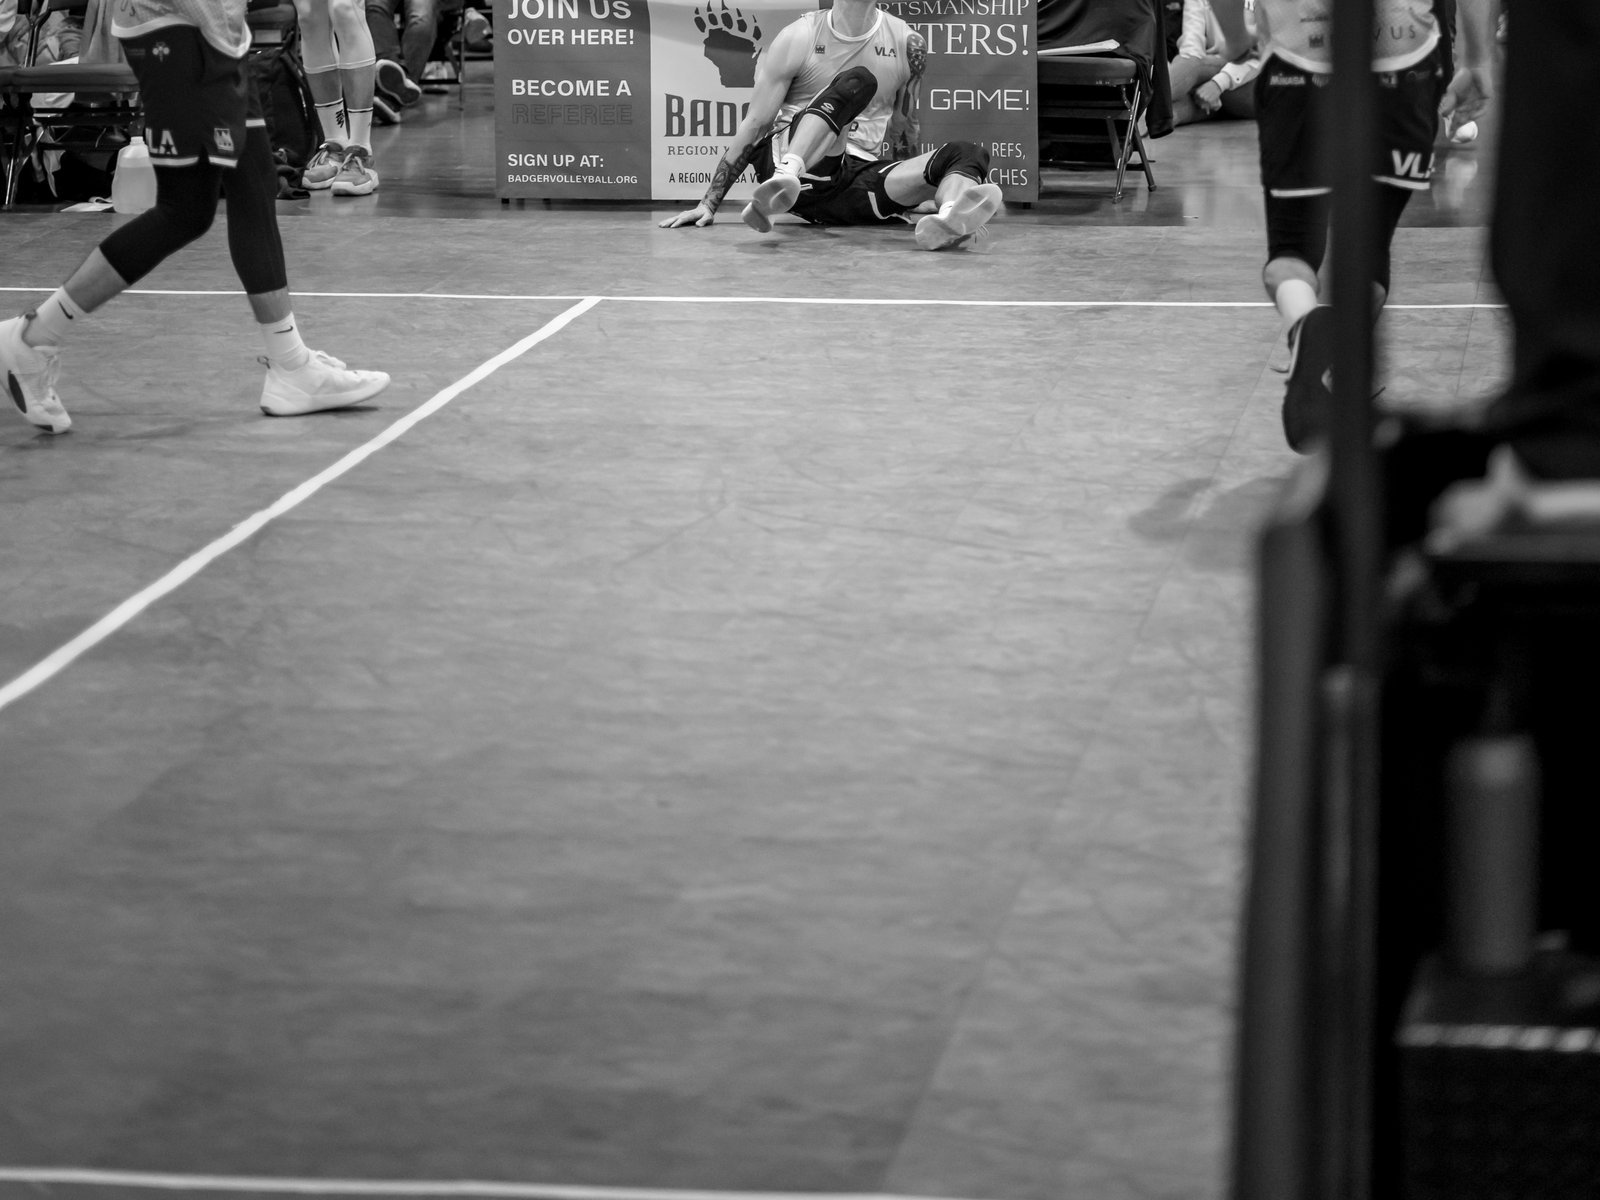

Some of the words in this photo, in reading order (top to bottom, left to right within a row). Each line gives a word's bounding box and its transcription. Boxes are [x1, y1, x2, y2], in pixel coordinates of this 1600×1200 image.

[507, 28, 565, 45] OVER
[571, 28, 634, 45] HERE!
[906, 22, 1029, 56] TERS!
[874, 46, 897, 58] VLA
[512, 79, 610, 97] BECOME
[615, 79, 632, 97] A
[930, 88, 1030, 111] GAME!
[511, 103, 634, 126] REFEREE
[664, 93, 750, 137] BAD
[667, 145, 719, 156] REGION
[991, 142, 1026, 160] REFS,
[507, 153, 548, 167] SIGN
[552, 154, 576, 167] UP
[579, 155, 604, 168] AT:
[507, 174, 638, 184] BADGERVOLLEYBALL.ORG
[668, 172, 676, 183] A
[678, 172, 711, 184] REGION
